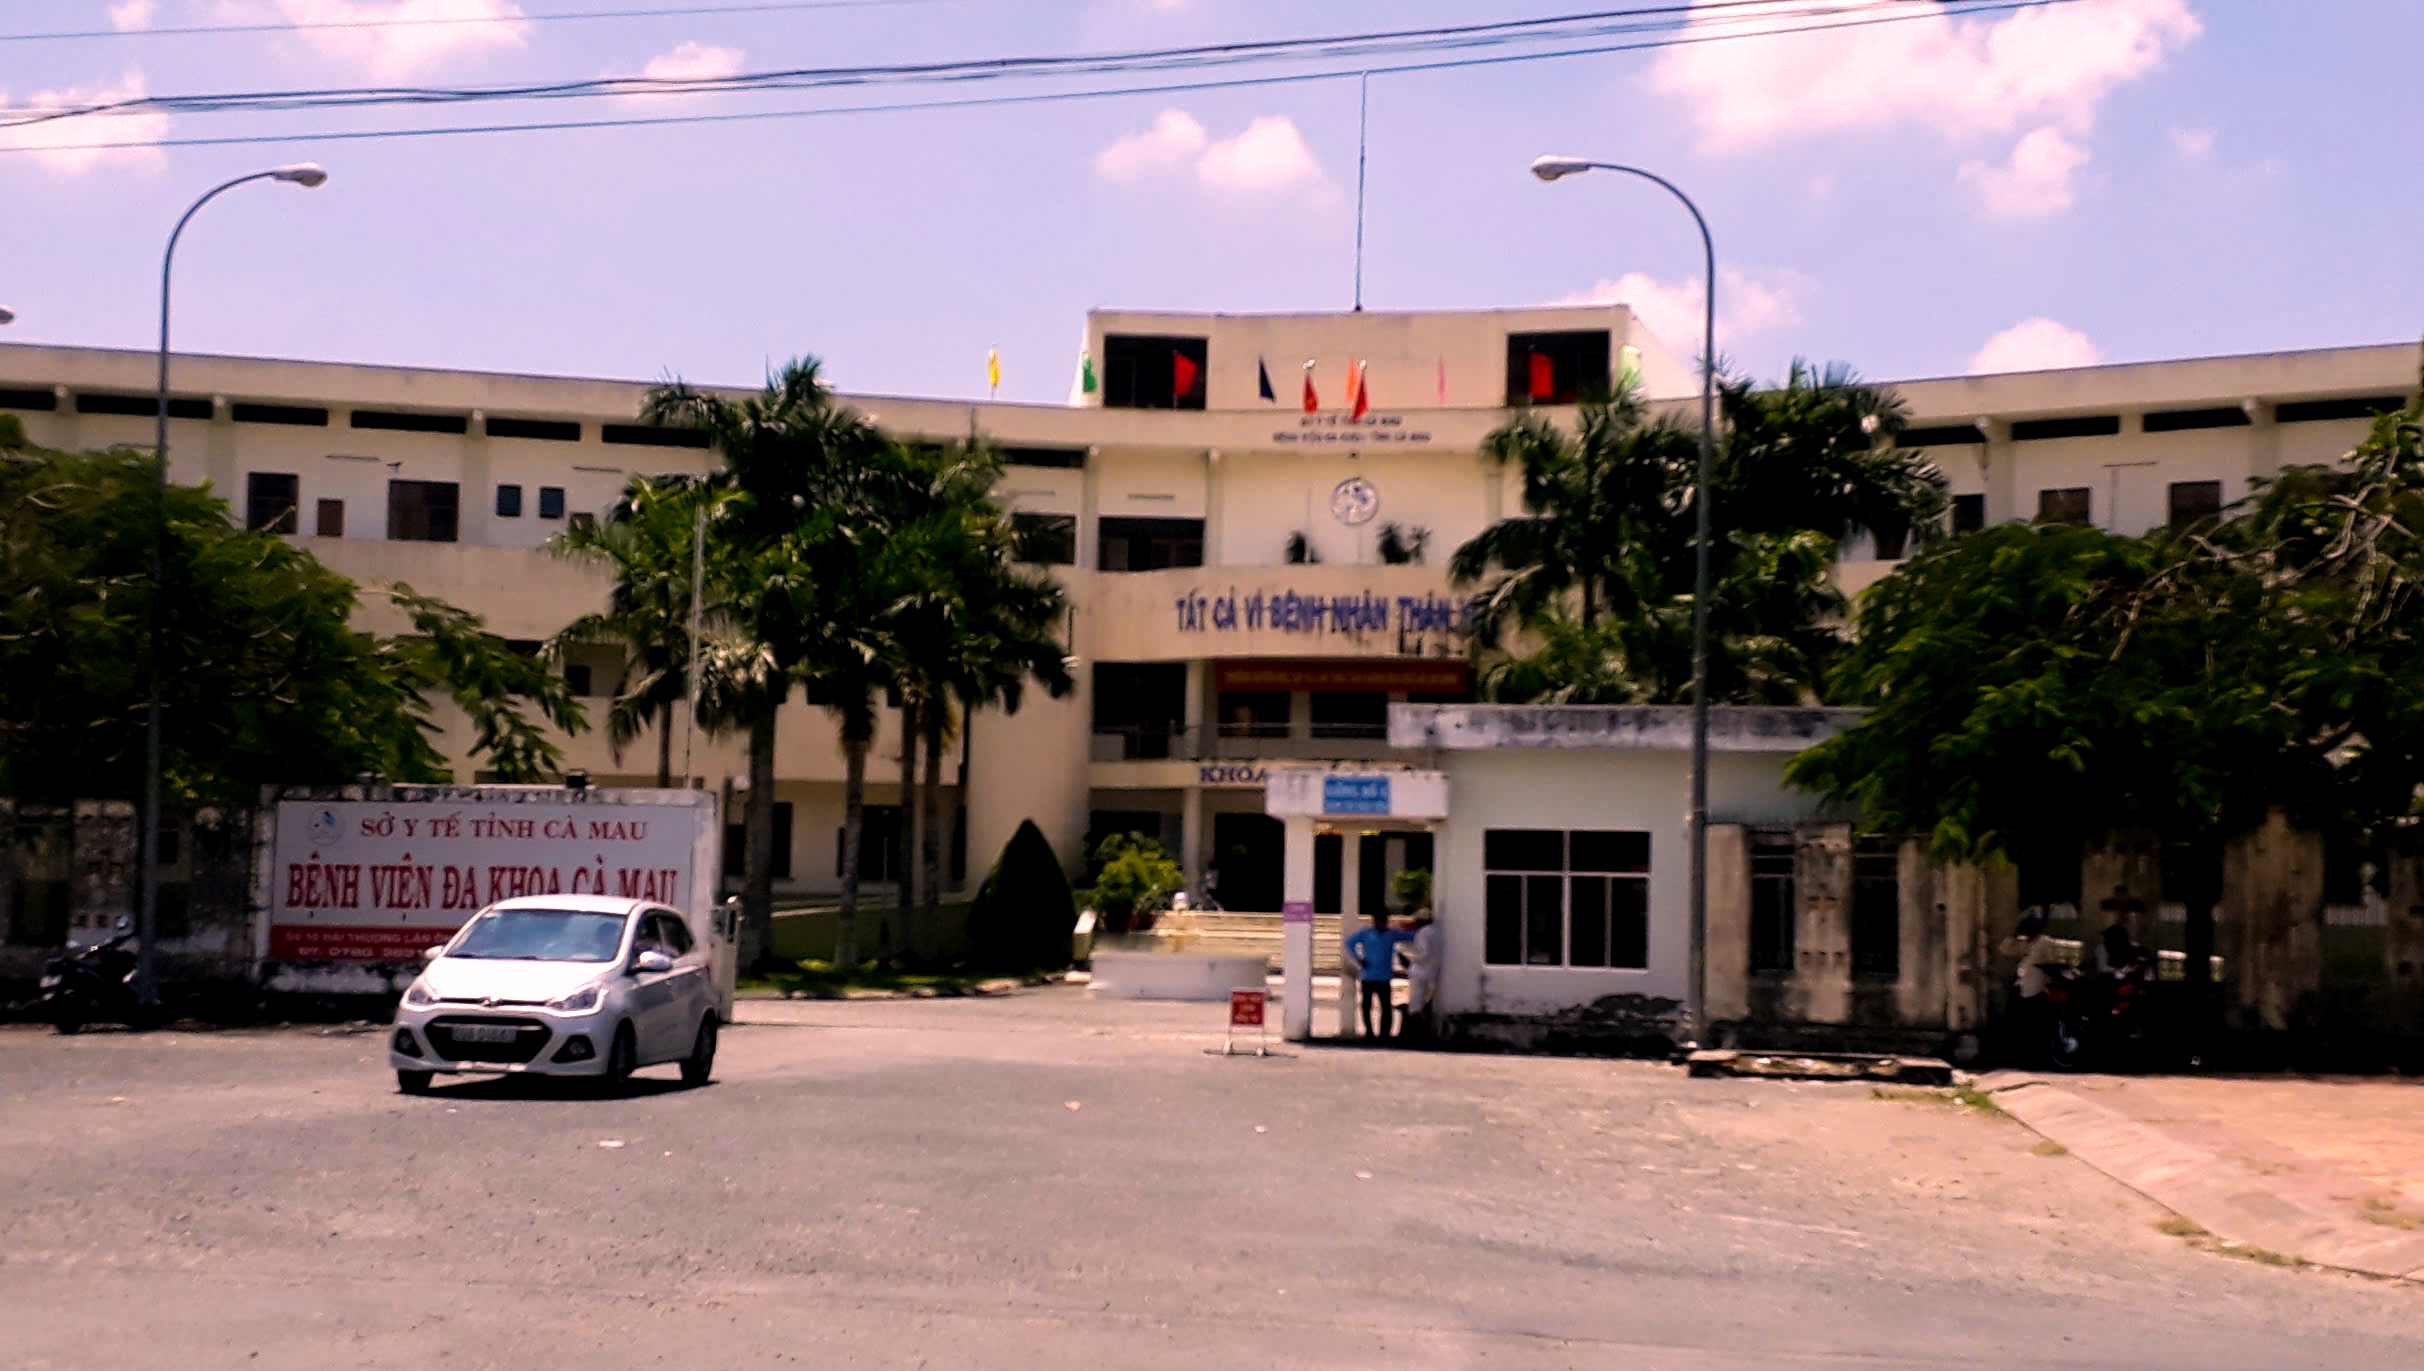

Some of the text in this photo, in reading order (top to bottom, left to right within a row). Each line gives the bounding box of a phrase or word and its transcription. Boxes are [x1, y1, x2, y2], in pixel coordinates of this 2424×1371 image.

[361, 811, 648, 841] SỞ Y TẾ TỈNH CÀ MAU
[287, 851, 361, 918] BỆNH
[369, 851, 434, 921] VIỆN
[442, 864, 480, 910] ĐA
[488, 865, 561, 905] KHOA
